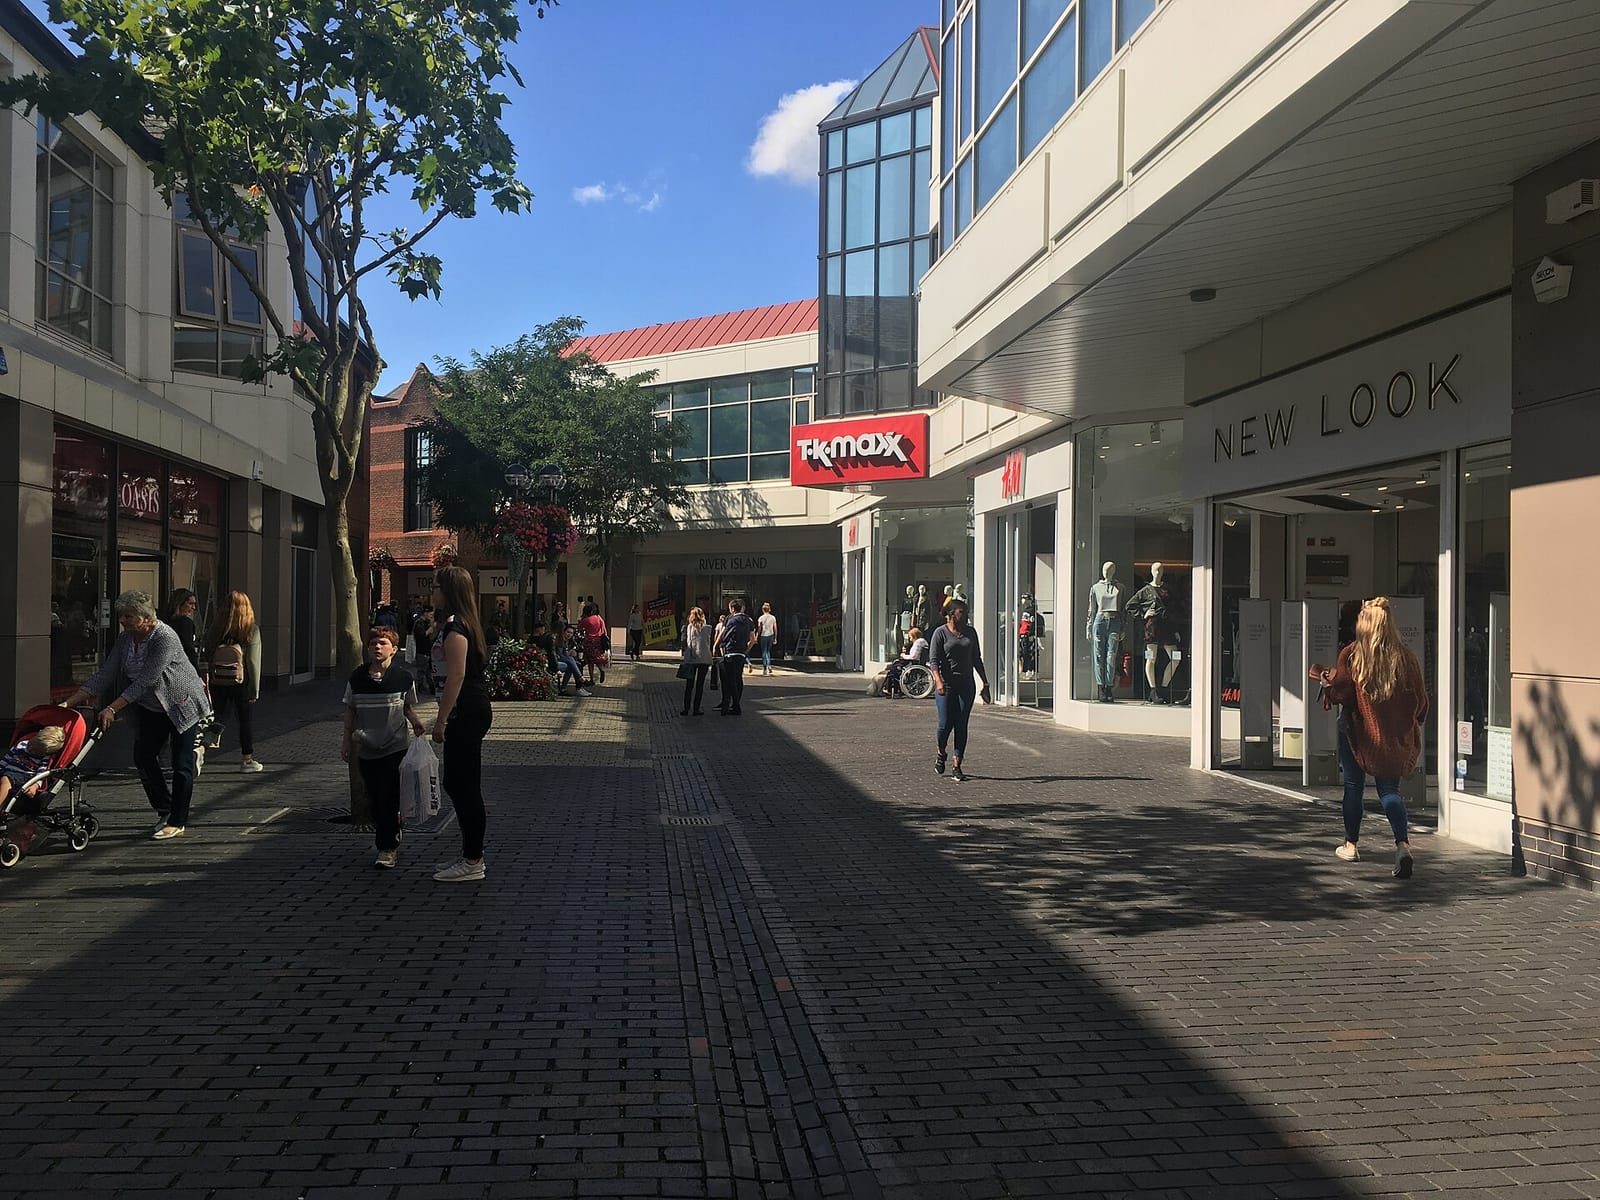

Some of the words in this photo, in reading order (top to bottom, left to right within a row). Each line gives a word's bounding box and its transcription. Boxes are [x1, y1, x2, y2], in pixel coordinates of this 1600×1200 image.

[1213, 404, 1296, 463] NEW
[1320, 353, 1463, 436] LOOK
[121, 482, 160, 513] OASIS
[699, 558, 727, 570] RIVER
[730, 557, 768, 570] ISLAND
